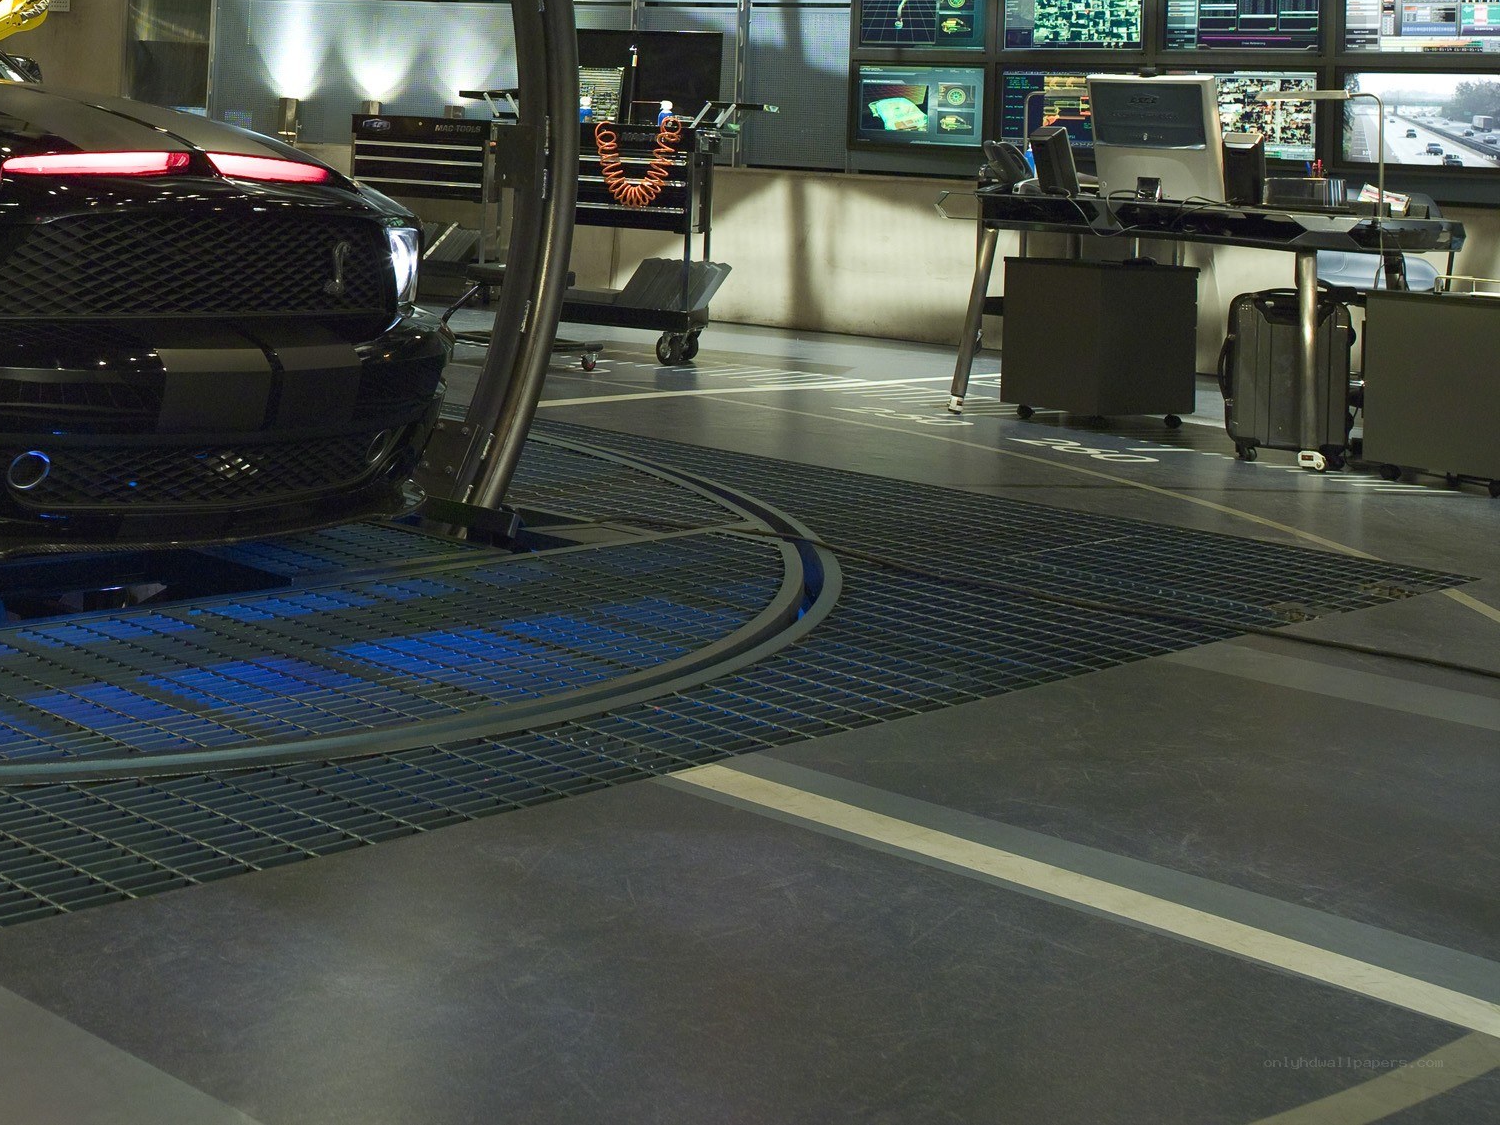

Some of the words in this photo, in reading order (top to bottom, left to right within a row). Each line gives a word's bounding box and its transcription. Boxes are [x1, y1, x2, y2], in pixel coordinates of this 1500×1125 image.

[434, 124, 454, 132] MAC
[456, 125, 481, 133] TOOLS
[831, 406, 974, 426] 250
[1005, 437, 1160, 463] 260
